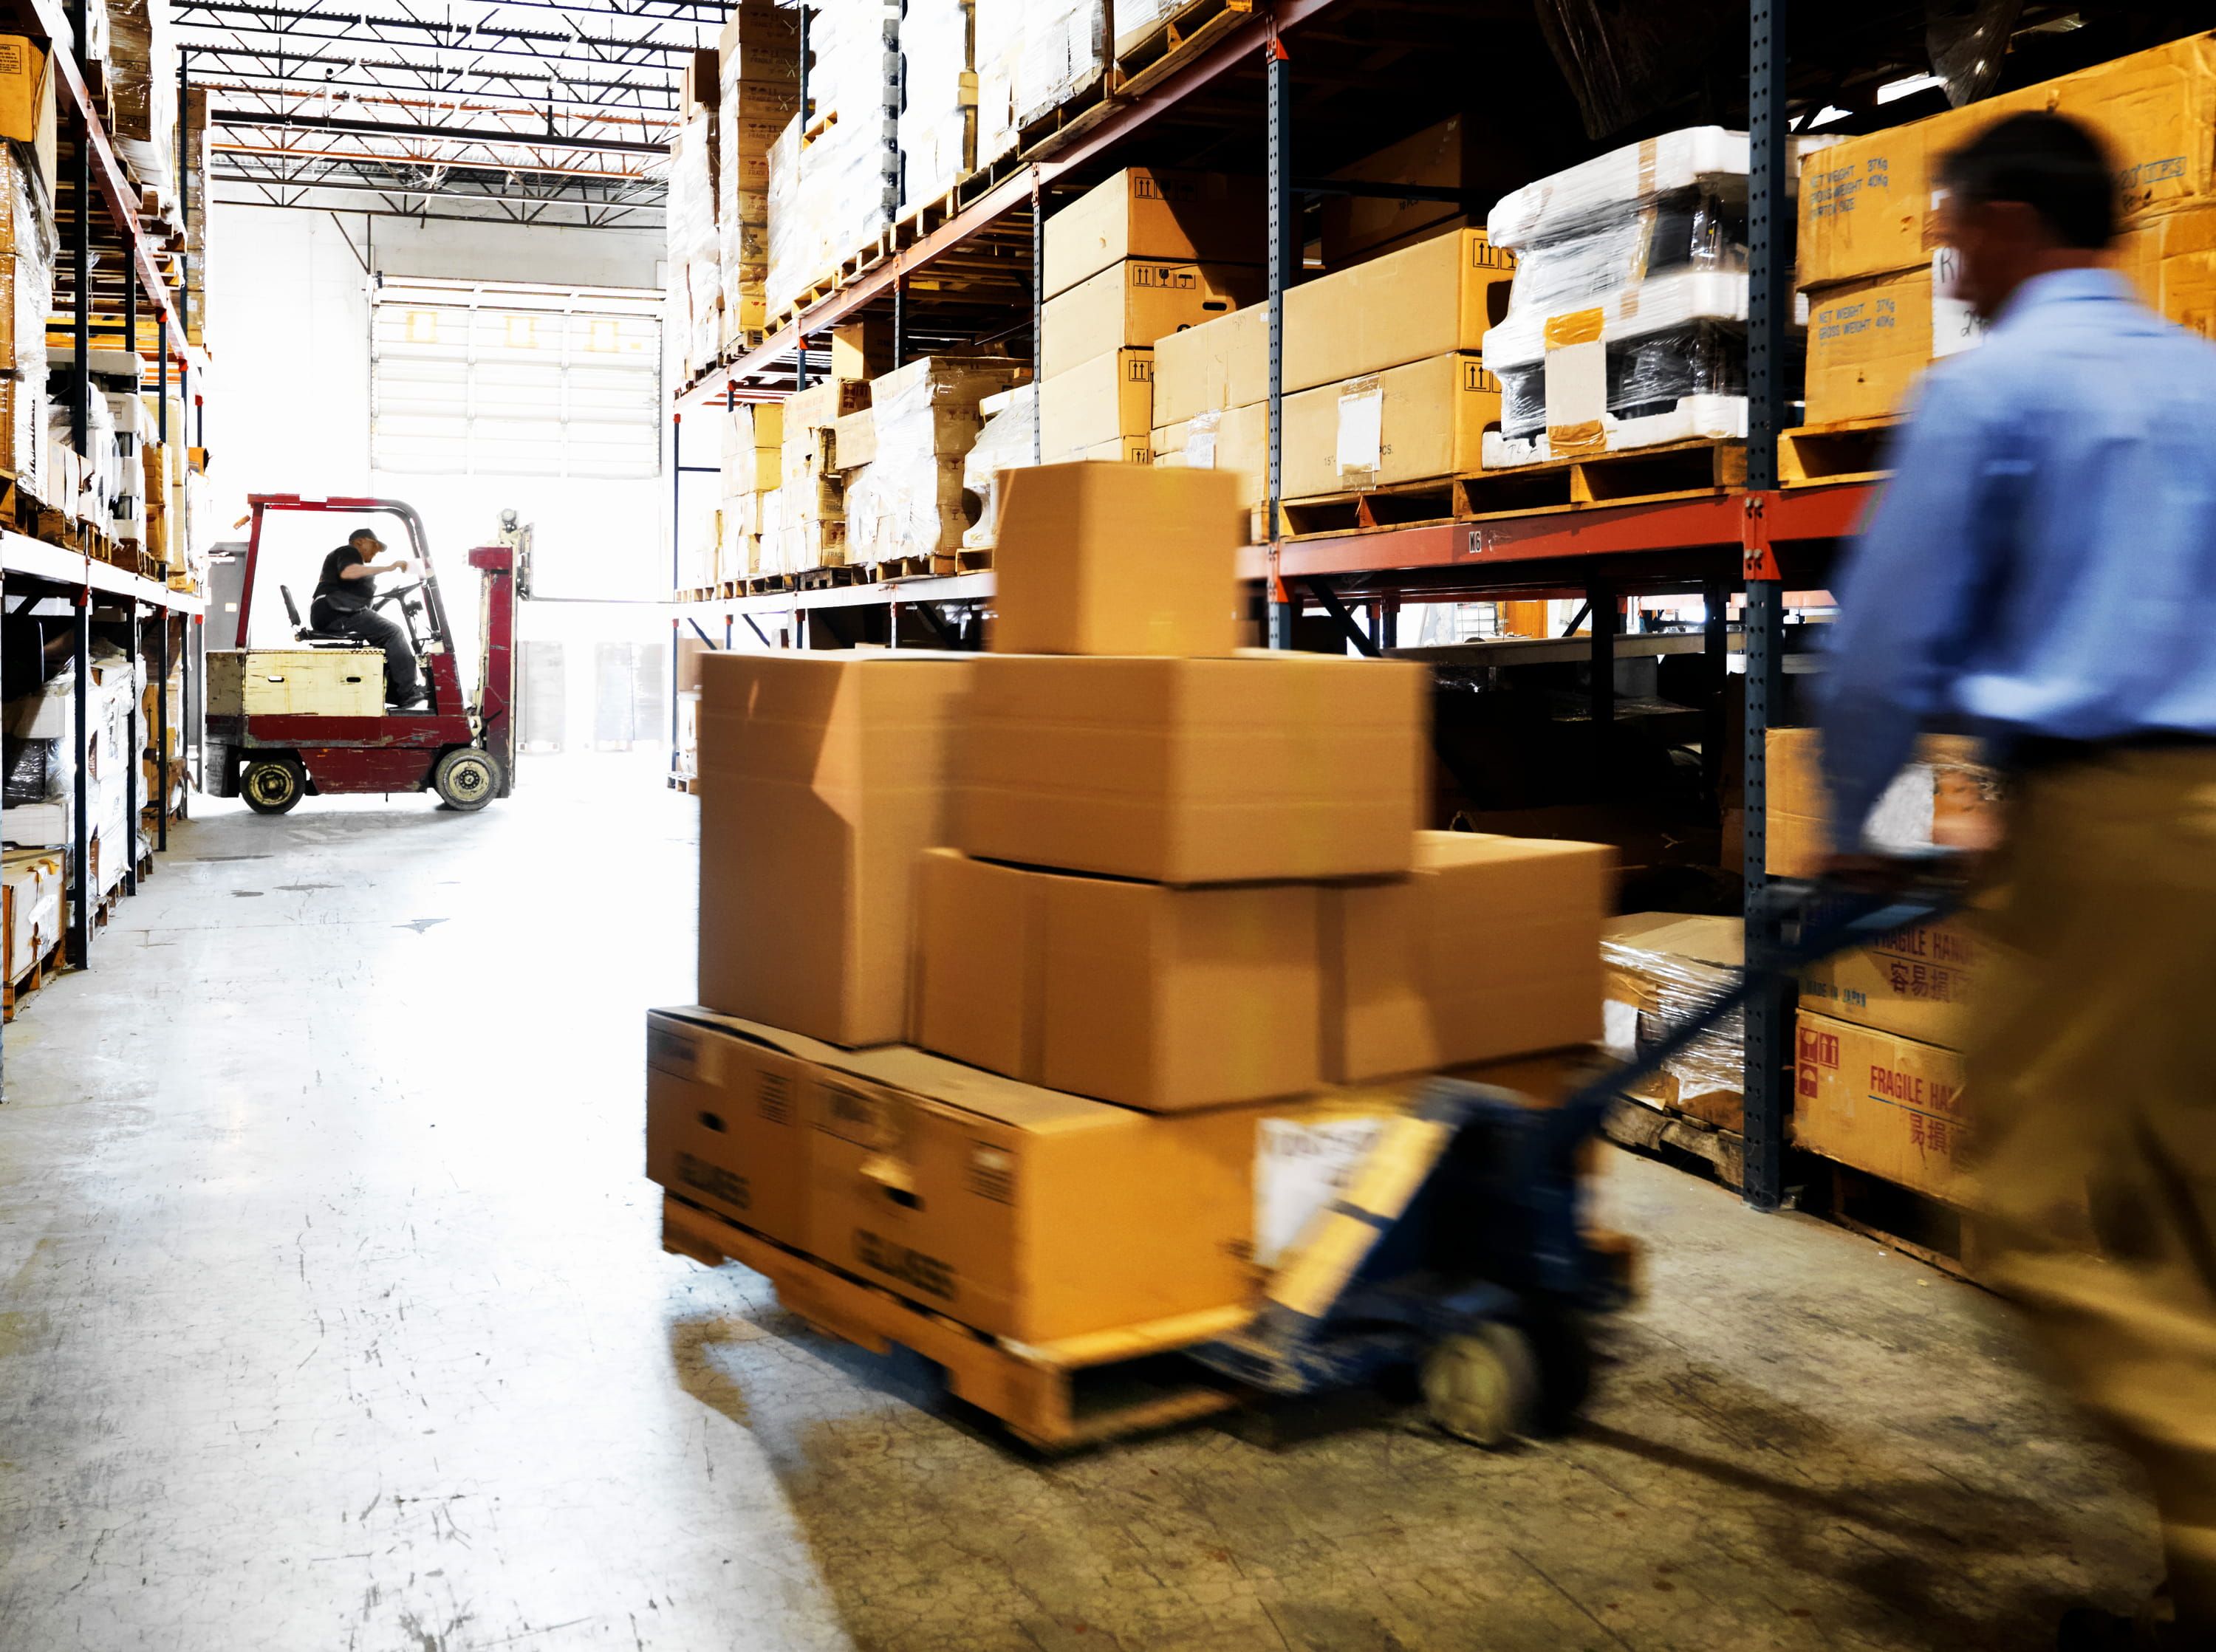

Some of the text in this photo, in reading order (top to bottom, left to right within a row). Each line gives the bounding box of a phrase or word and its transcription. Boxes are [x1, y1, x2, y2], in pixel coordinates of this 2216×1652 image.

[1819, 310, 1833, 323] NET
[1836, 301, 1866, 320] WEIGHT
[1819, 325, 1841, 340] GROSS
[1843, 318, 1872, 335] WEIGHT
[1870, 1065, 1923, 1106] FRAGILE
